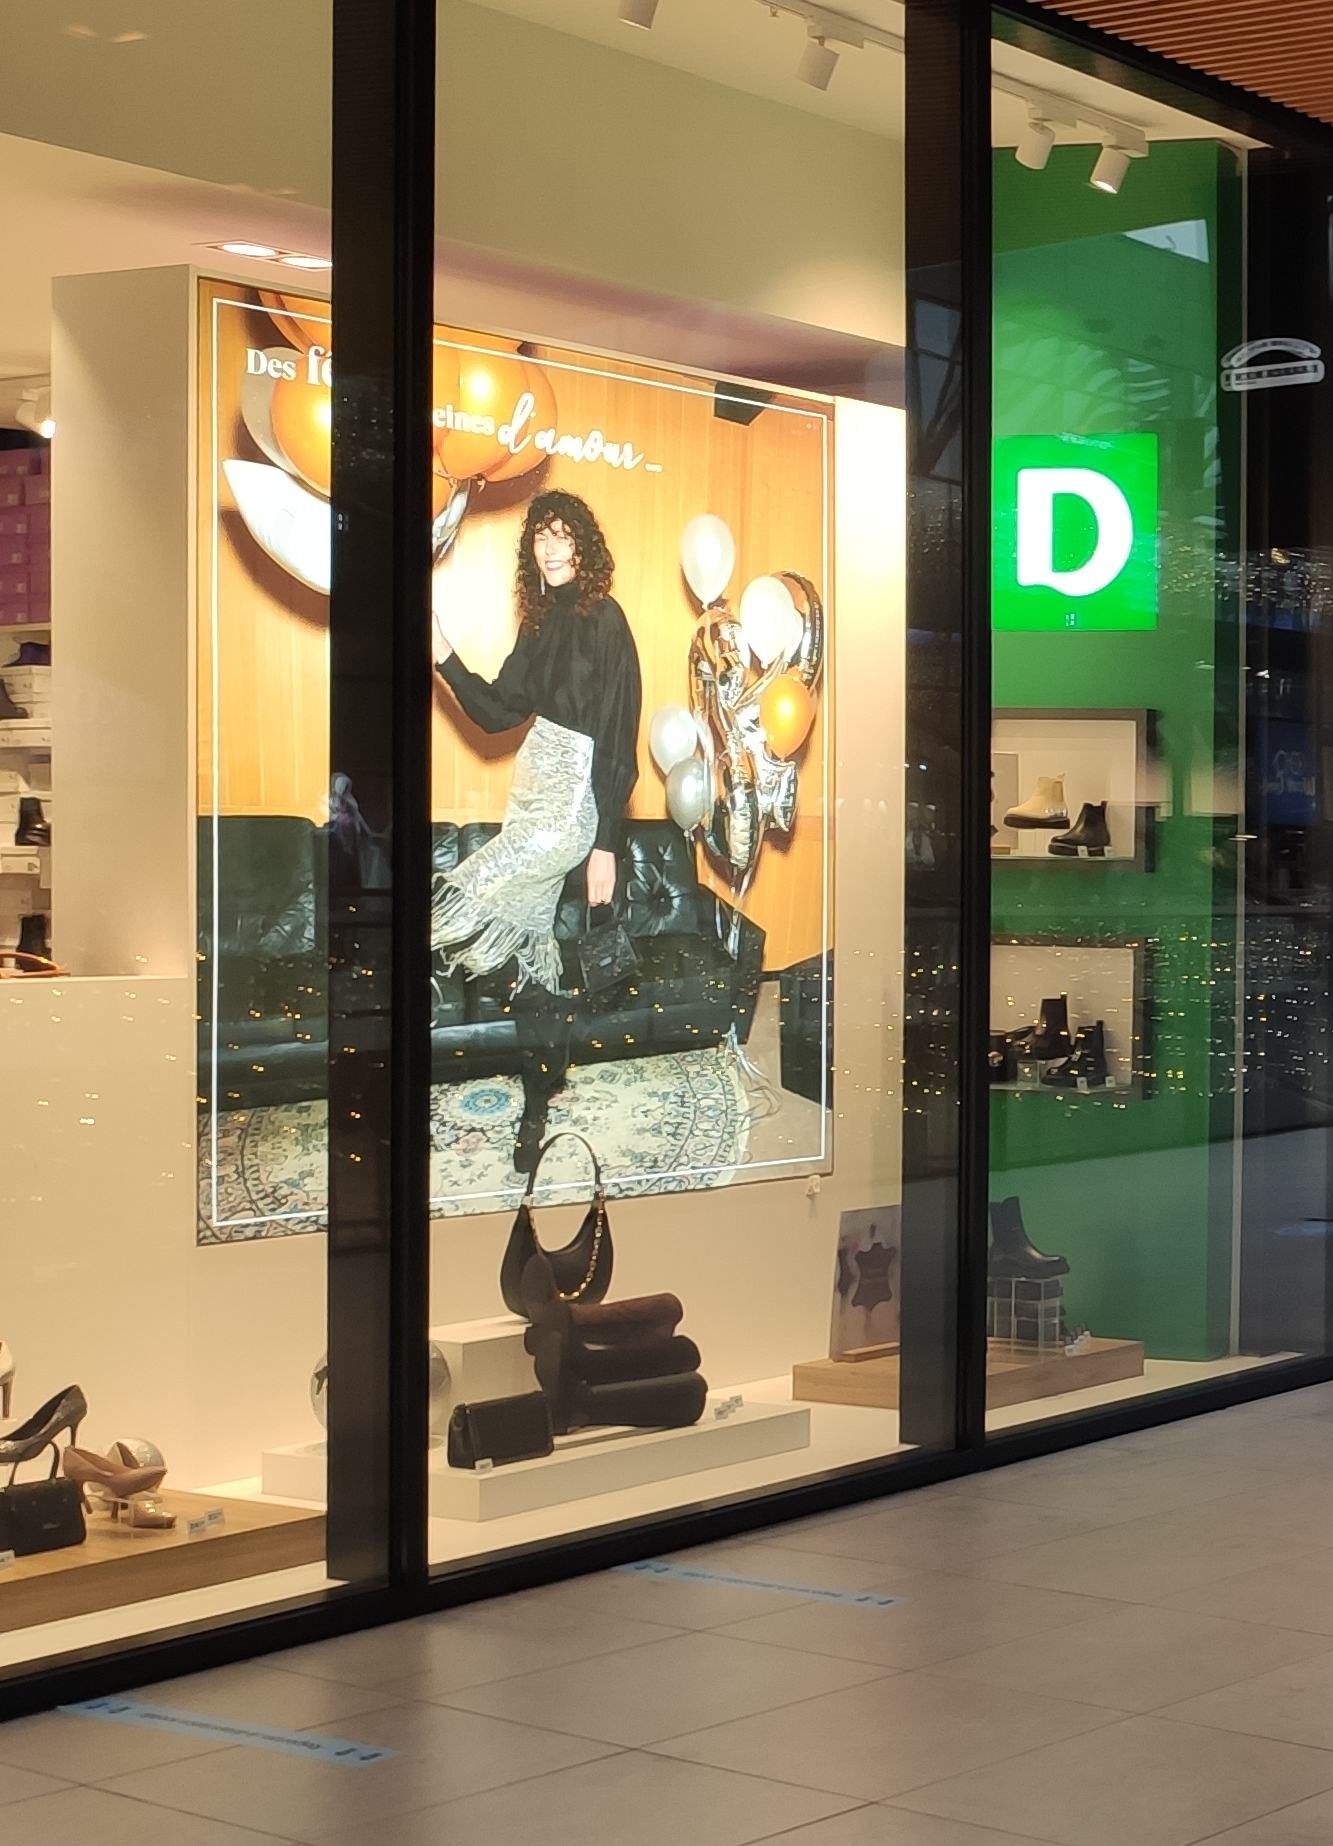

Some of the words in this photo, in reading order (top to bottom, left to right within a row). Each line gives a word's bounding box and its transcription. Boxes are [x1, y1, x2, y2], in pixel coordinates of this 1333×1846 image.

[246, 348, 297, 381] Des
[433, 404, 496, 436] eines
[1017, 466, 1133, 597] D
